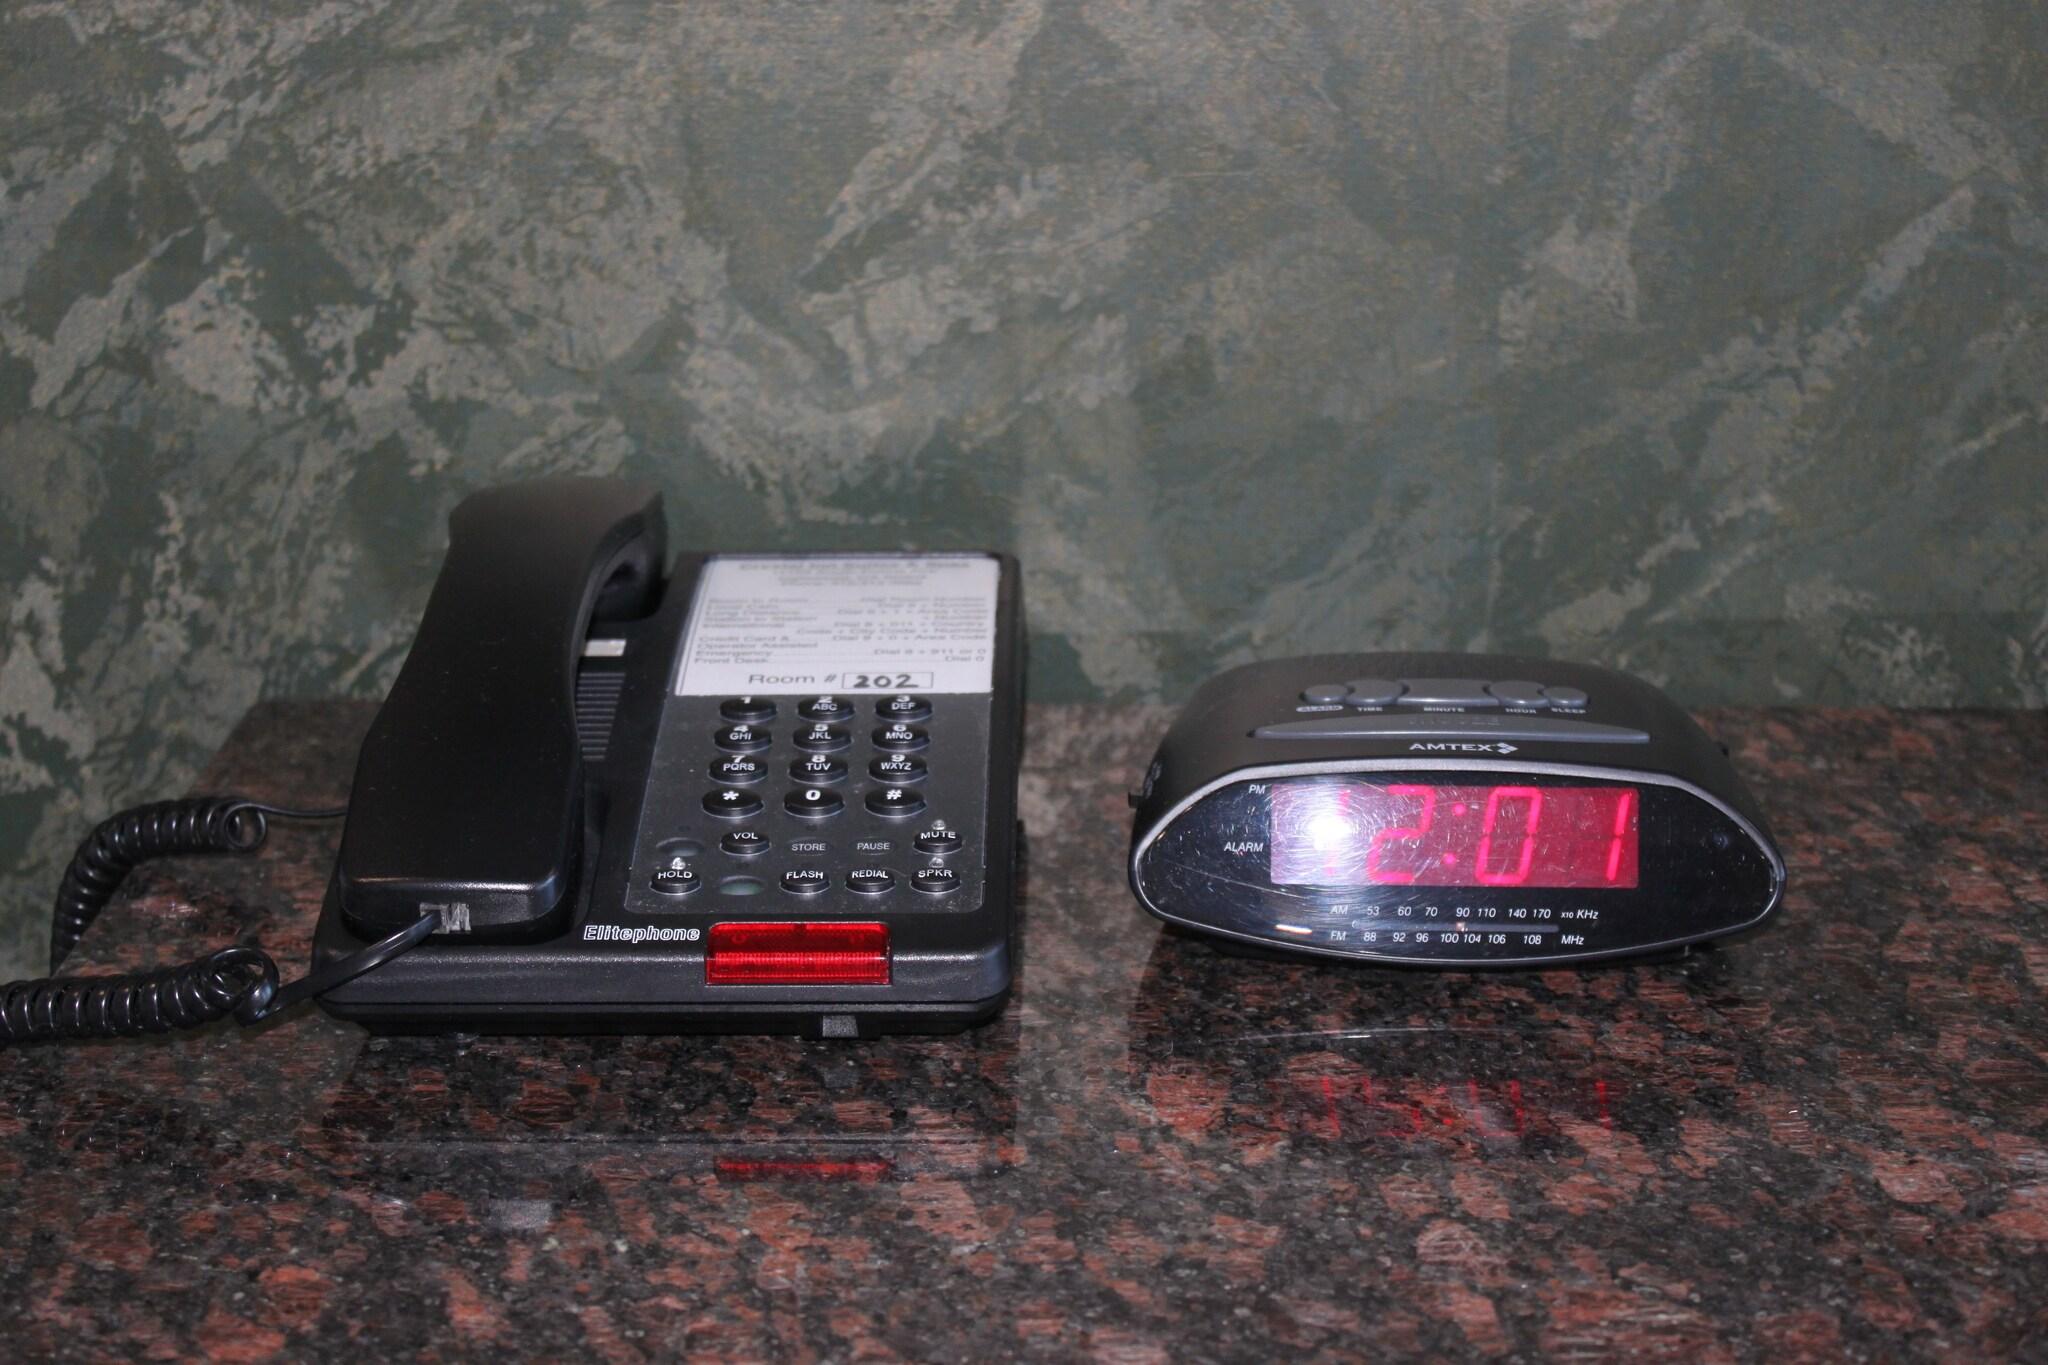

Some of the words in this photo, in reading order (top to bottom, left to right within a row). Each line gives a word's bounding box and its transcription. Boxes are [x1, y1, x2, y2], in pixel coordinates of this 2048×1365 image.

[748, 673, 816, 685] Room
[824, 673, 838, 684] #
[853, 674, 920, 689] 202
[812, 703, 839, 711] ABC
[891, 702, 916, 710] DEF
[814, 724, 829, 732] 5
[893, 724, 907, 732] 6
[729, 732, 752, 740] GHI
[808, 732, 832, 740] JKL
[885, 732, 913, 740] MNO
[1408, 742, 1494, 752] AMTEX
[731, 755, 746, 763] 7
[811, 755, 827, 763] 8
[891, 754, 906, 762] 9
[723, 763, 756, 771] PQRS
[805, 763, 832, 771] TUV
[880, 762, 912, 771] WXYZ
[1248, 784, 1267, 795] PM
[805, 790, 821, 801] 0
[733, 832, 759, 840] VOL
[920, 831, 957, 840] MUTE
[791, 843, 826, 852] STORE
[857, 842, 891, 850] PAUSE
[1223, 841, 1265, 852] ALARM
[658, 871, 693, 880] HOLD
[786, 870, 824, 880] FLASH
[852, 870, 889, 879] REDIAL
[918, 869, 954, 878] SPKR
[1329, 905, 1349, 915] AM
[1366, 906, 1381, 916] 53
[1398, 906, 1412, 916] 60
[1425, 907, 1439, 917] 70
[1456, 907, 1471, 918] 90
[1477, 908, 1497, 918] 110
[1508, 908, 1528, 919] 140
[1532, 908, 1552, 919] 170
[1576, 909, 1600, 920] KHz
[583, 925, 701, 944] Elitephone
[1330, 931, 1347, 941] FM
[1363, 932, 1378, 942] 88
[1392, 932, 1407, 942] 92
[1416, 932, 1430, 943] 96
[1440, 933, 1460, 943] 100
[1463, 934, 1482, 943] 104
[1487, 934, 1507, 944] 106
[1523, 935, 1543, 945] 108
[1561, 935, 1585, 945] MHz
